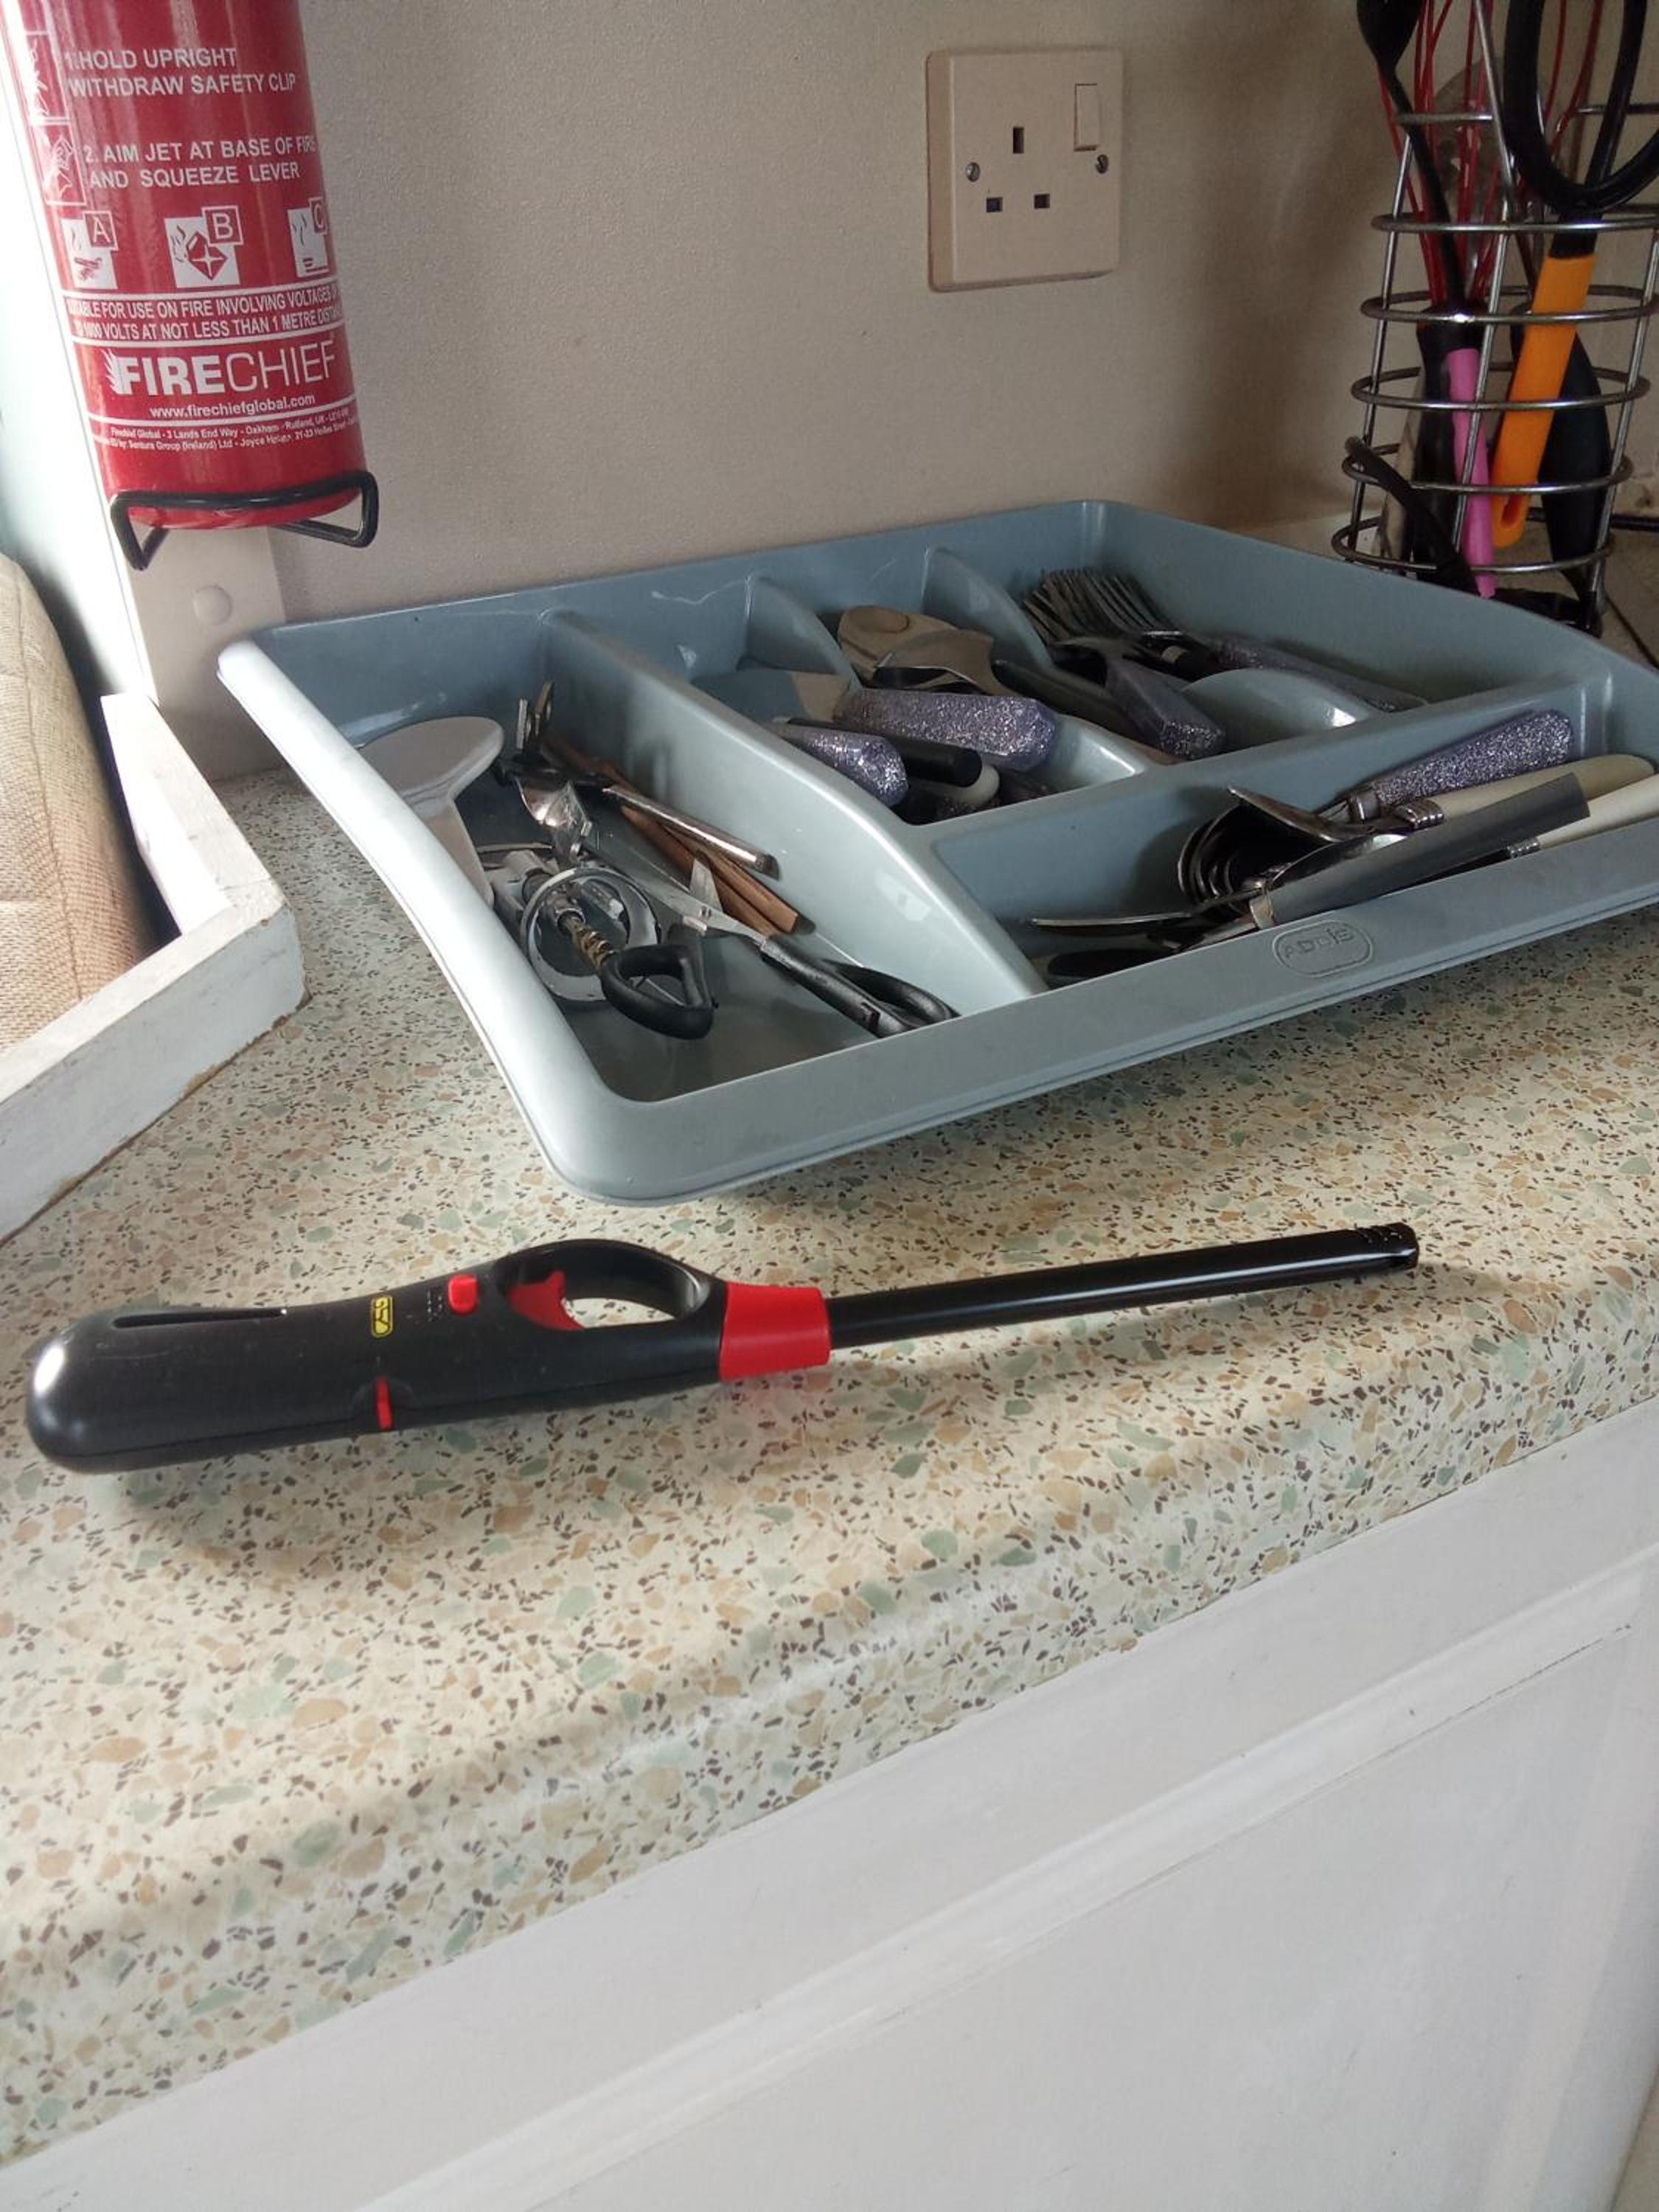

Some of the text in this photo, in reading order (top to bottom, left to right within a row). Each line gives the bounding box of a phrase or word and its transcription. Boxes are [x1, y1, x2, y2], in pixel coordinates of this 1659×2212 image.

[144, 47, 236, 69] UPRIGHT
[69, 72, 296, 97] WITHDRAW SAFETY CLIP
[104, 143, 139, 163] AIM
[145, 142, 182, 161] JET
[189, 141, 214, 160] AT
[220, 138, 271, 159] BASE
[275, 136, 293, 154] OF
[90, 161, 299, 189] AND SQUEEZE LEVER
[93, 216, 111, 243] A
[212, 212, 234, 240] B
[101, 301, 127, 319] FOR
[127, 301, 155, 319] USE
[157, 300, 178, 319] ON
[181, 299, 213, 318] FIRE
[215, 292, 286, 316] INVOLVING
[102, 322, 139, 341] VOLTS
[142, 324, 158, 340] AT
[160, 322, 189, 340] NOT
[192, 319, 230, 338] LESS
[231, 316, 270, 335] THAN
[281, 308, 317, 331] METRE
[100, 339, 335, 396] FIRECHIEF
[150, 394, 316, 419] www.firechiefglobal.com
